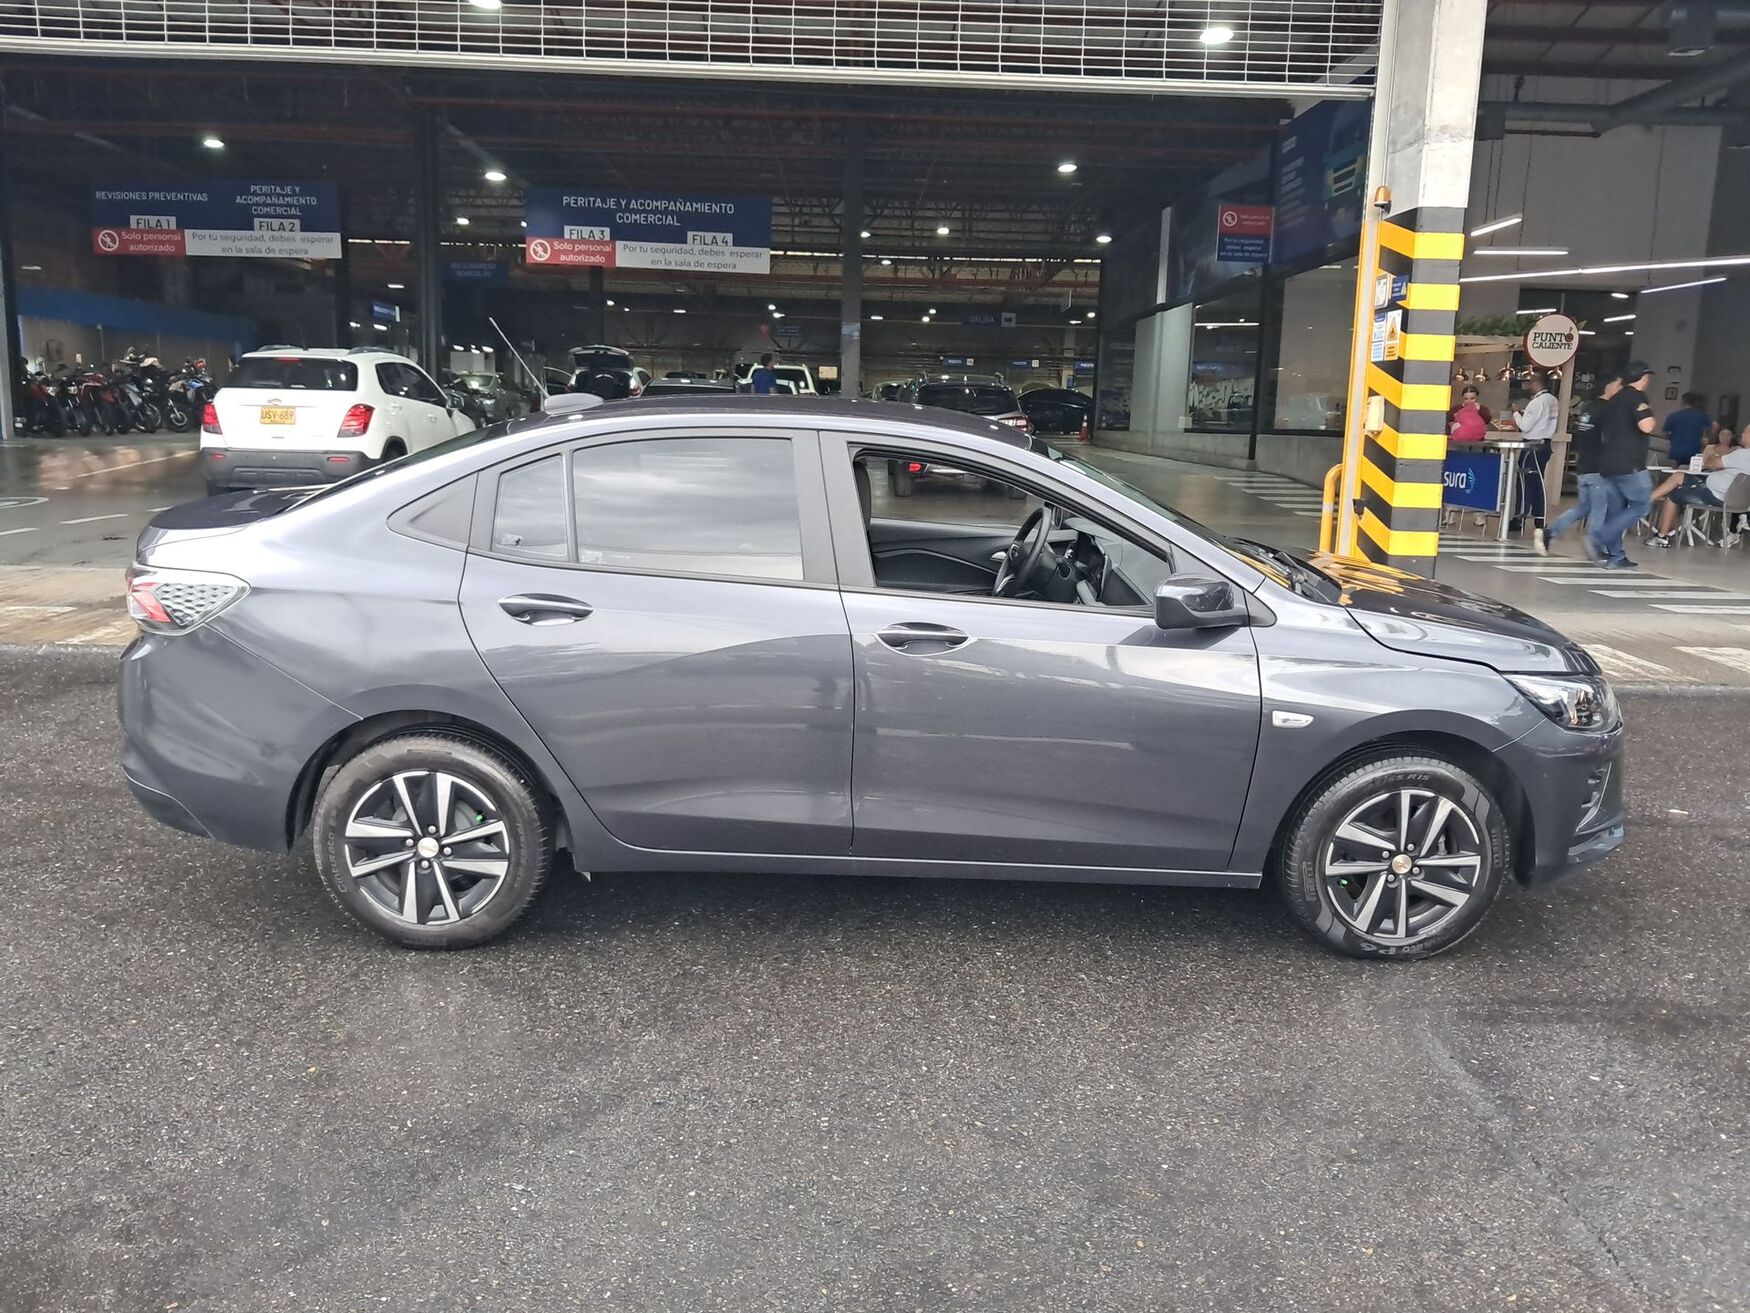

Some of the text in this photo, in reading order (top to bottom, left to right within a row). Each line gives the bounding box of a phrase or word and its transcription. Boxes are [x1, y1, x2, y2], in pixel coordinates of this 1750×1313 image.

[250, 185, 301, 194] PERITAJE Y
[95, 191, 208, 202] REVISIONES PREVENTIVAS
[235, 194, 317, 205] ACOMPAÑAMIENTO
[562, 196, 735, 214] PERITAJE Y ACOMPAÑAMIENTO
[251, 206, 302, 216] COMERCIAL
[136, 218, 163, 229] FILA
[616, 212, 681, 226] COMERCIAL
[258, 221, 296, 232] FILA 2
[121, 231, 181, 242] Solo personal
[192, 232, 206, 241] Por
[208, 232, 218, 241] tu
[268, 234, 296, 243] debes
[299, 236, 334, 244] esperar
[569, 228, 605, 240] FILA 3
[692, 234, 729, 246] FILA 4
[128, 244, 176, 252] autorizado
[234, 245, 243, 254] la
[245, 246, 262, 255] sala
[264, 246, 276, 255] de
[278, 248, 309, 256] espera
[553, 241, 612, 252] Solo personal
[623, 244, 762, 260] Por tu seguridad, debes esperar
[560, 254, 606, 263] autorizado
[651, 257, 737, 270] en la sala de espera
[1532, 332, 1574, 342] PUNTO
[1532, 342, 1573, 350] CALIENTE
[1443, 471, 1467, 489] sura
